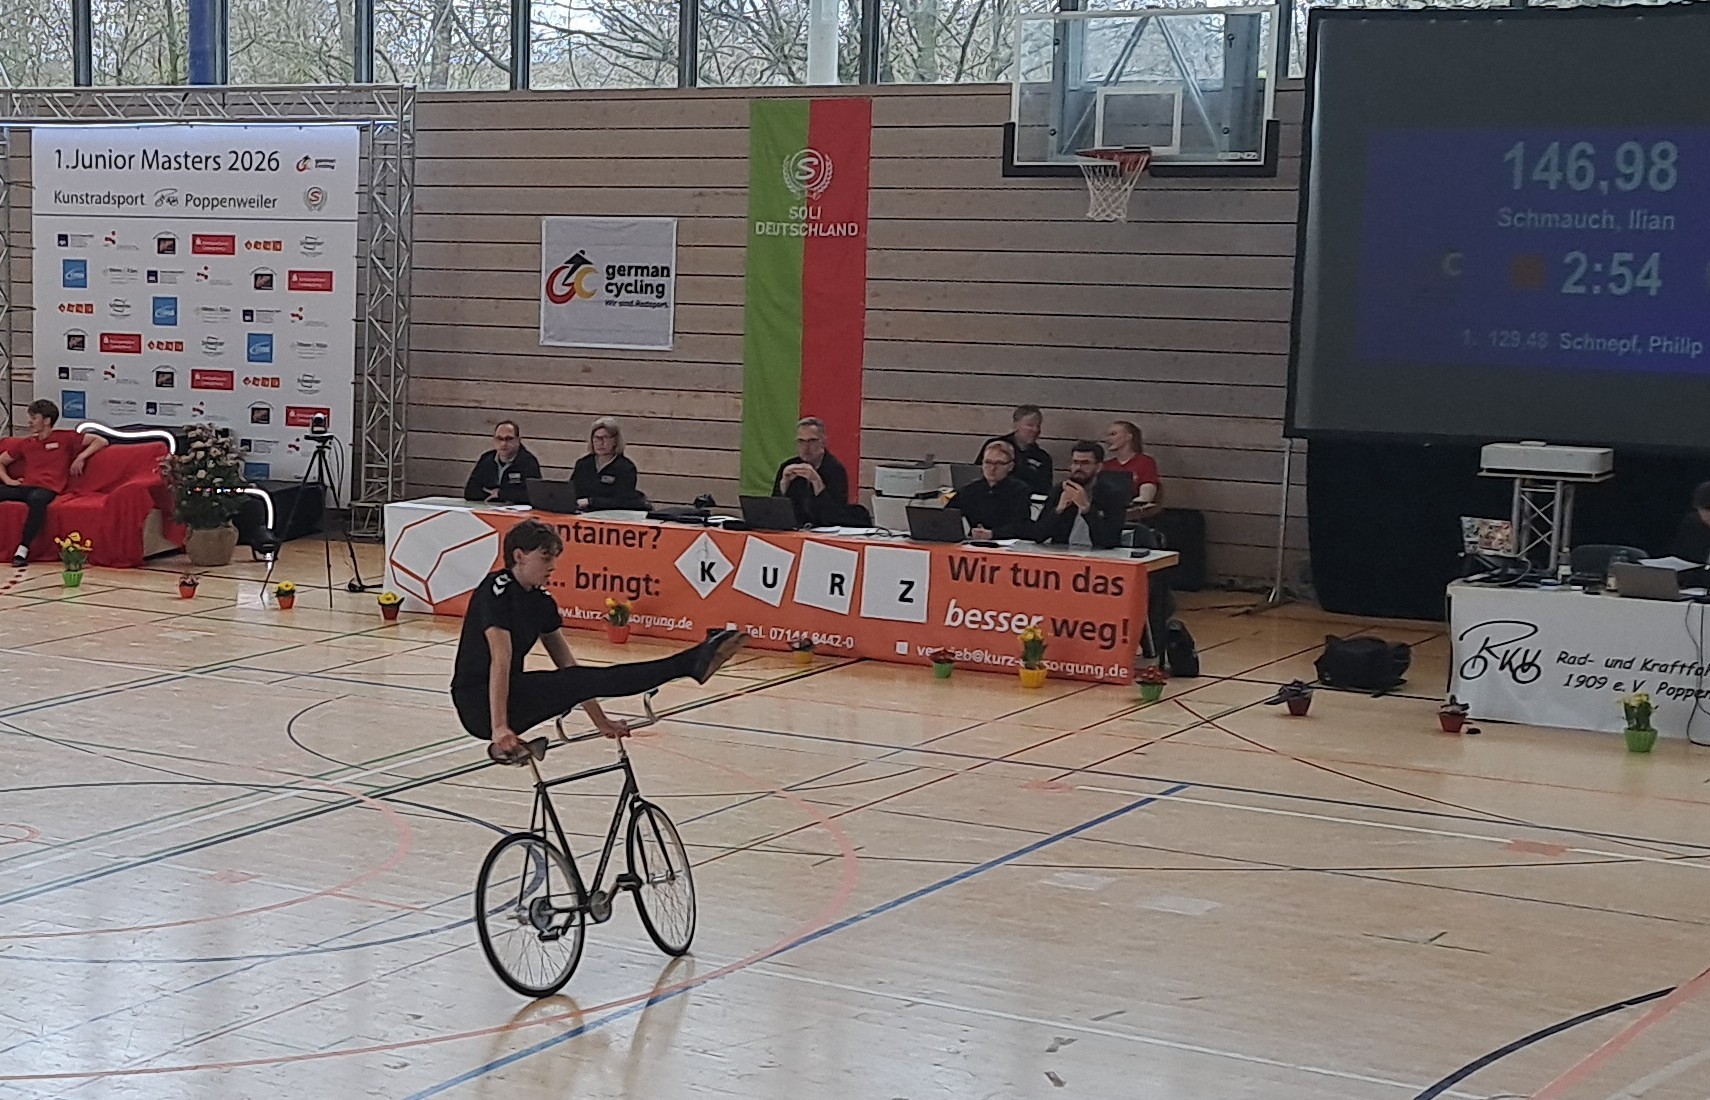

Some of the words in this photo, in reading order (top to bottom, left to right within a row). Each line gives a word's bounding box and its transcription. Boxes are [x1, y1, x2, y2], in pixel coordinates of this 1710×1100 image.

[141, 148, 222, 171] Masters
[227, 150, 281, 172] 2026
[1504, 140, 1678, 195] 146,98
[54, 189, 147, 209] Kunstradsport
[184, 193, 279, 211] Poppenweiler
[788, 205, 822, 220] SOLI
[755, 221, 859, 237] DEUTSCHLAND
[605, 264, 671, 281] german
[1561, 250, 1663, 297] 2:54
[604, 279, 666, 299] cycling
[557, 521, 662, 549] ntainer?
[575, 564, 660, 601] bringt:
[948, 555, 1001, 584] Wir
[1011, 562, 1061, 590] tun
[1072, 565, 1125, 596] das
[944, 599, 1044, 634] besser
[1051, 618, 1129, 650] weg!
[1556, 650, 1595, 666] Rad-
[1604, 657, 1636, 670] und
[1563, 673, 1608, 690] 1909
